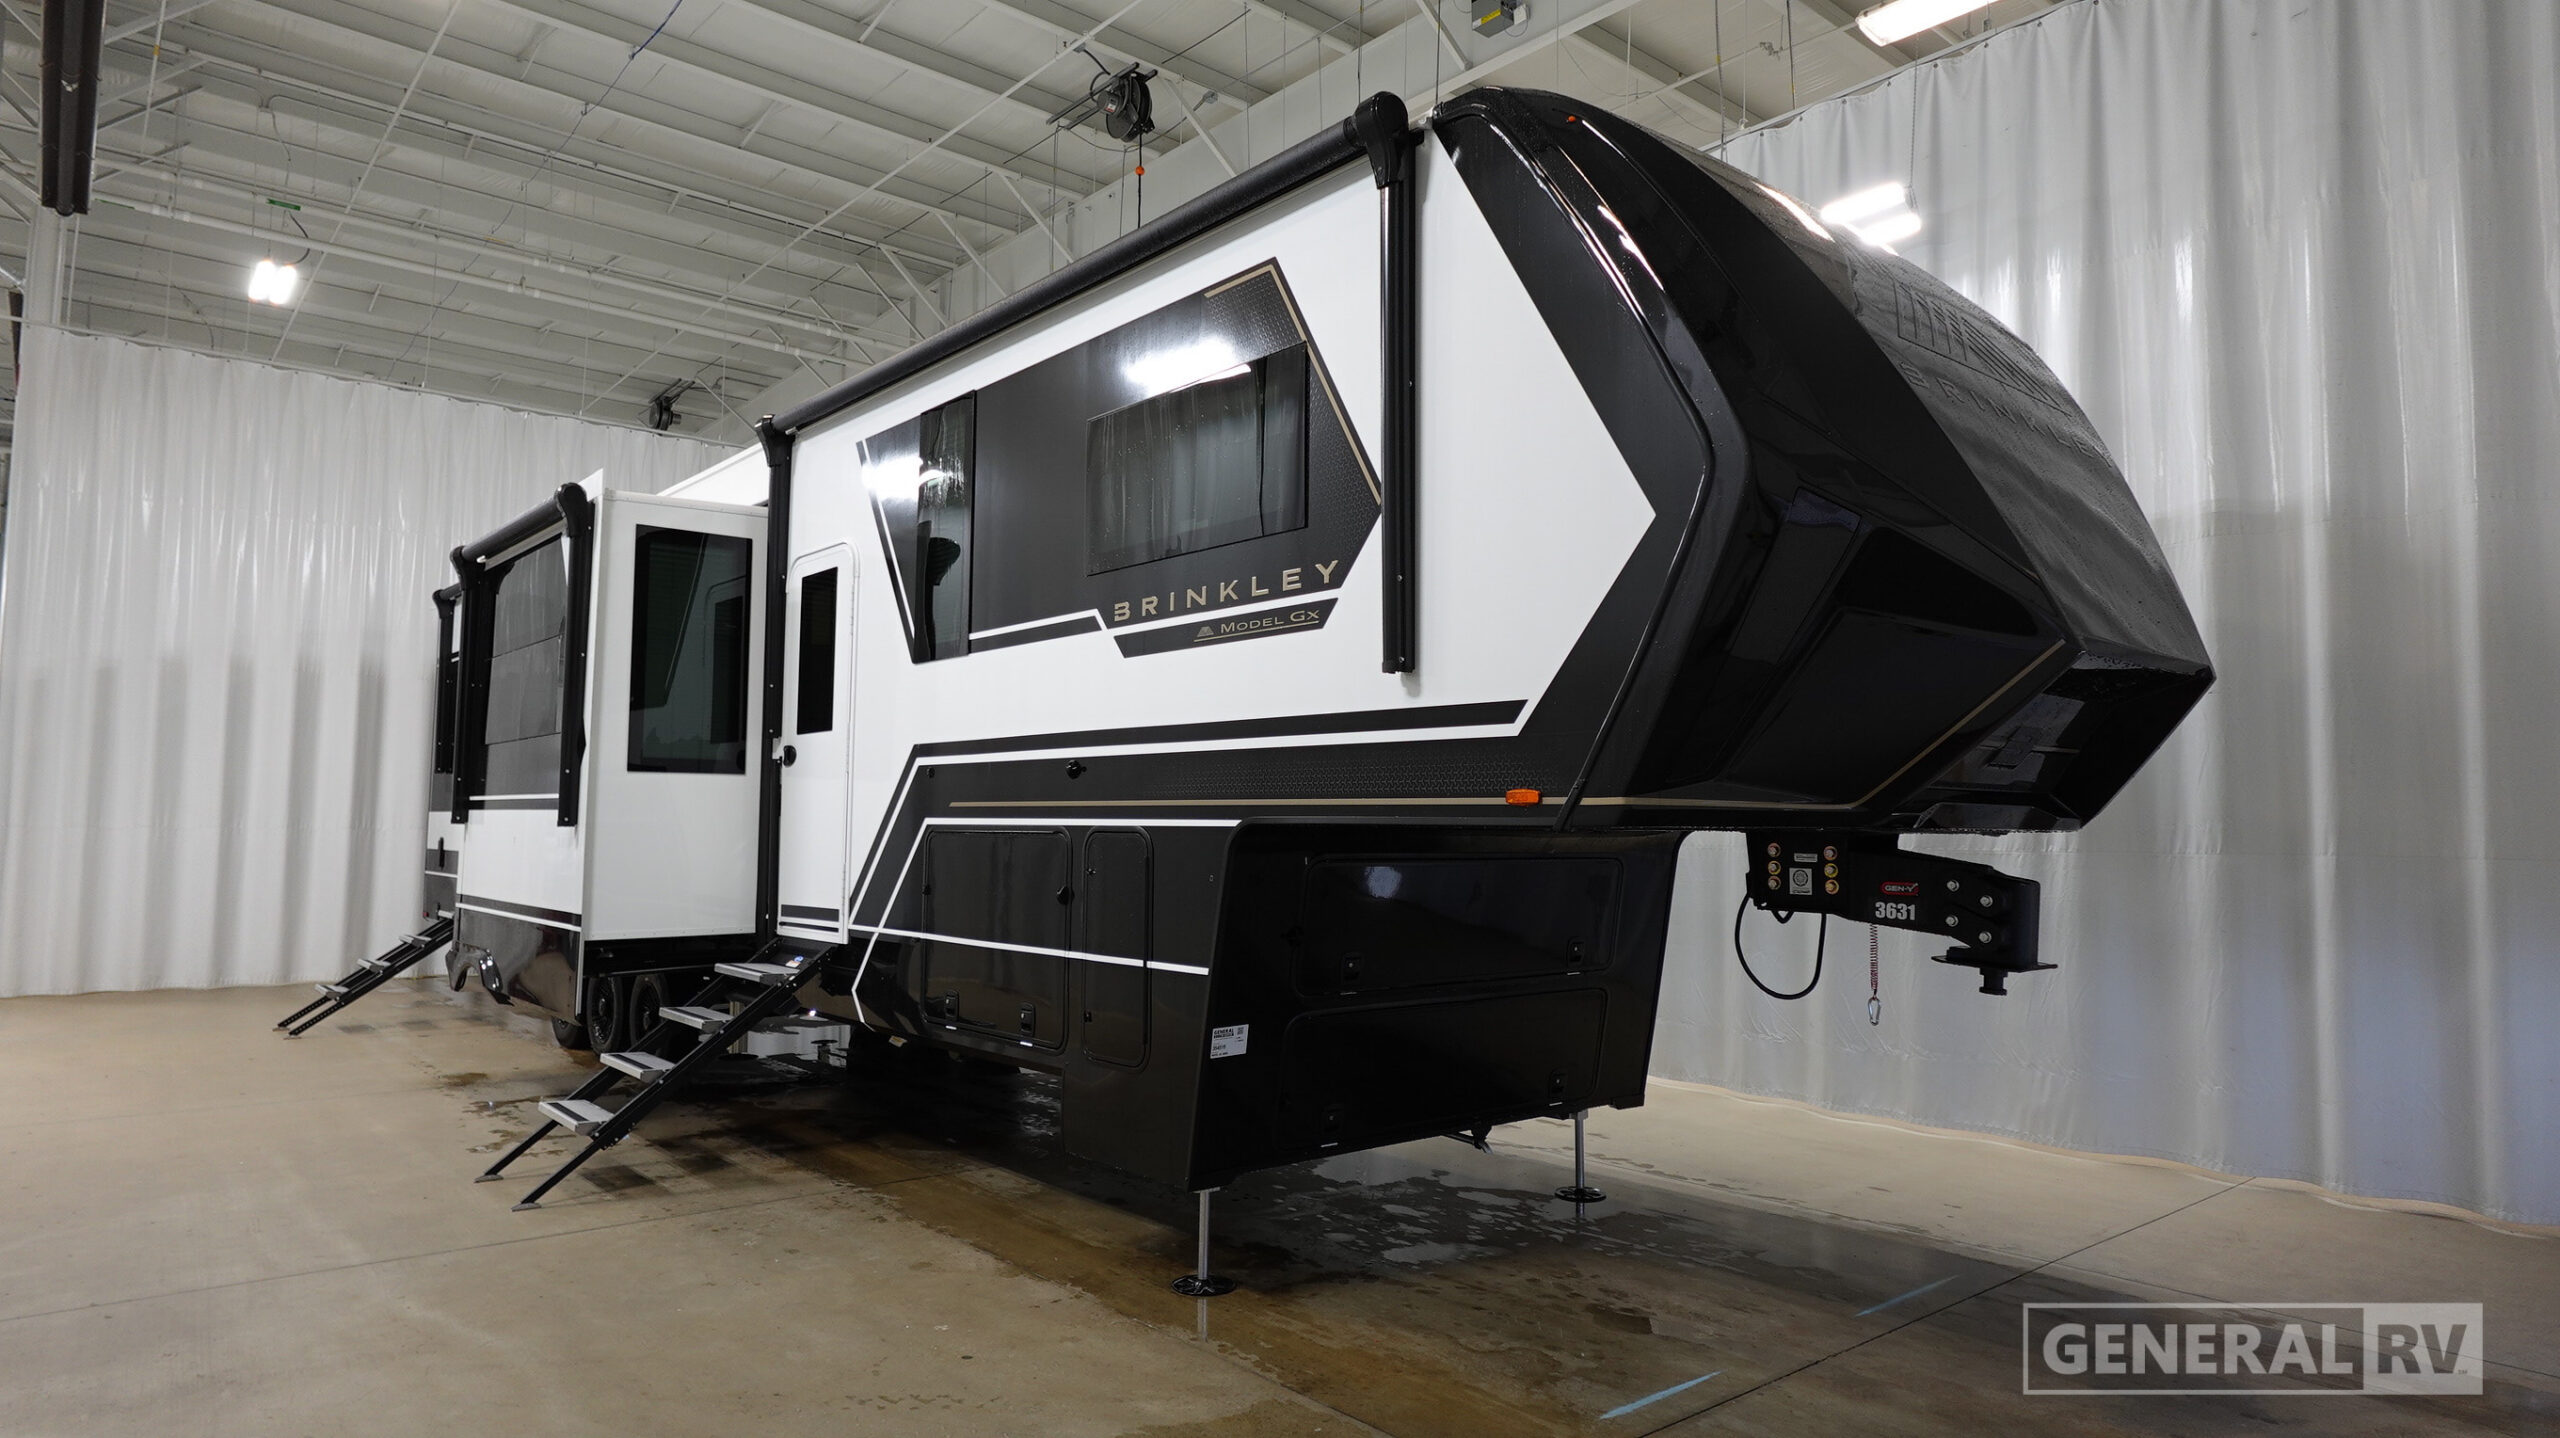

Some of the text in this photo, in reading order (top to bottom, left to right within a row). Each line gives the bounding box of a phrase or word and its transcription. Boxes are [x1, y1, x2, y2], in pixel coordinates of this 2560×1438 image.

[1899, 361, 2113, 468] BRINKLEY
[1113, 559, 1339, 622] BRINKLEY
[1884, 882, 1919, 892] GEN-Y
[1875, 901, 1916, 921] 3631
